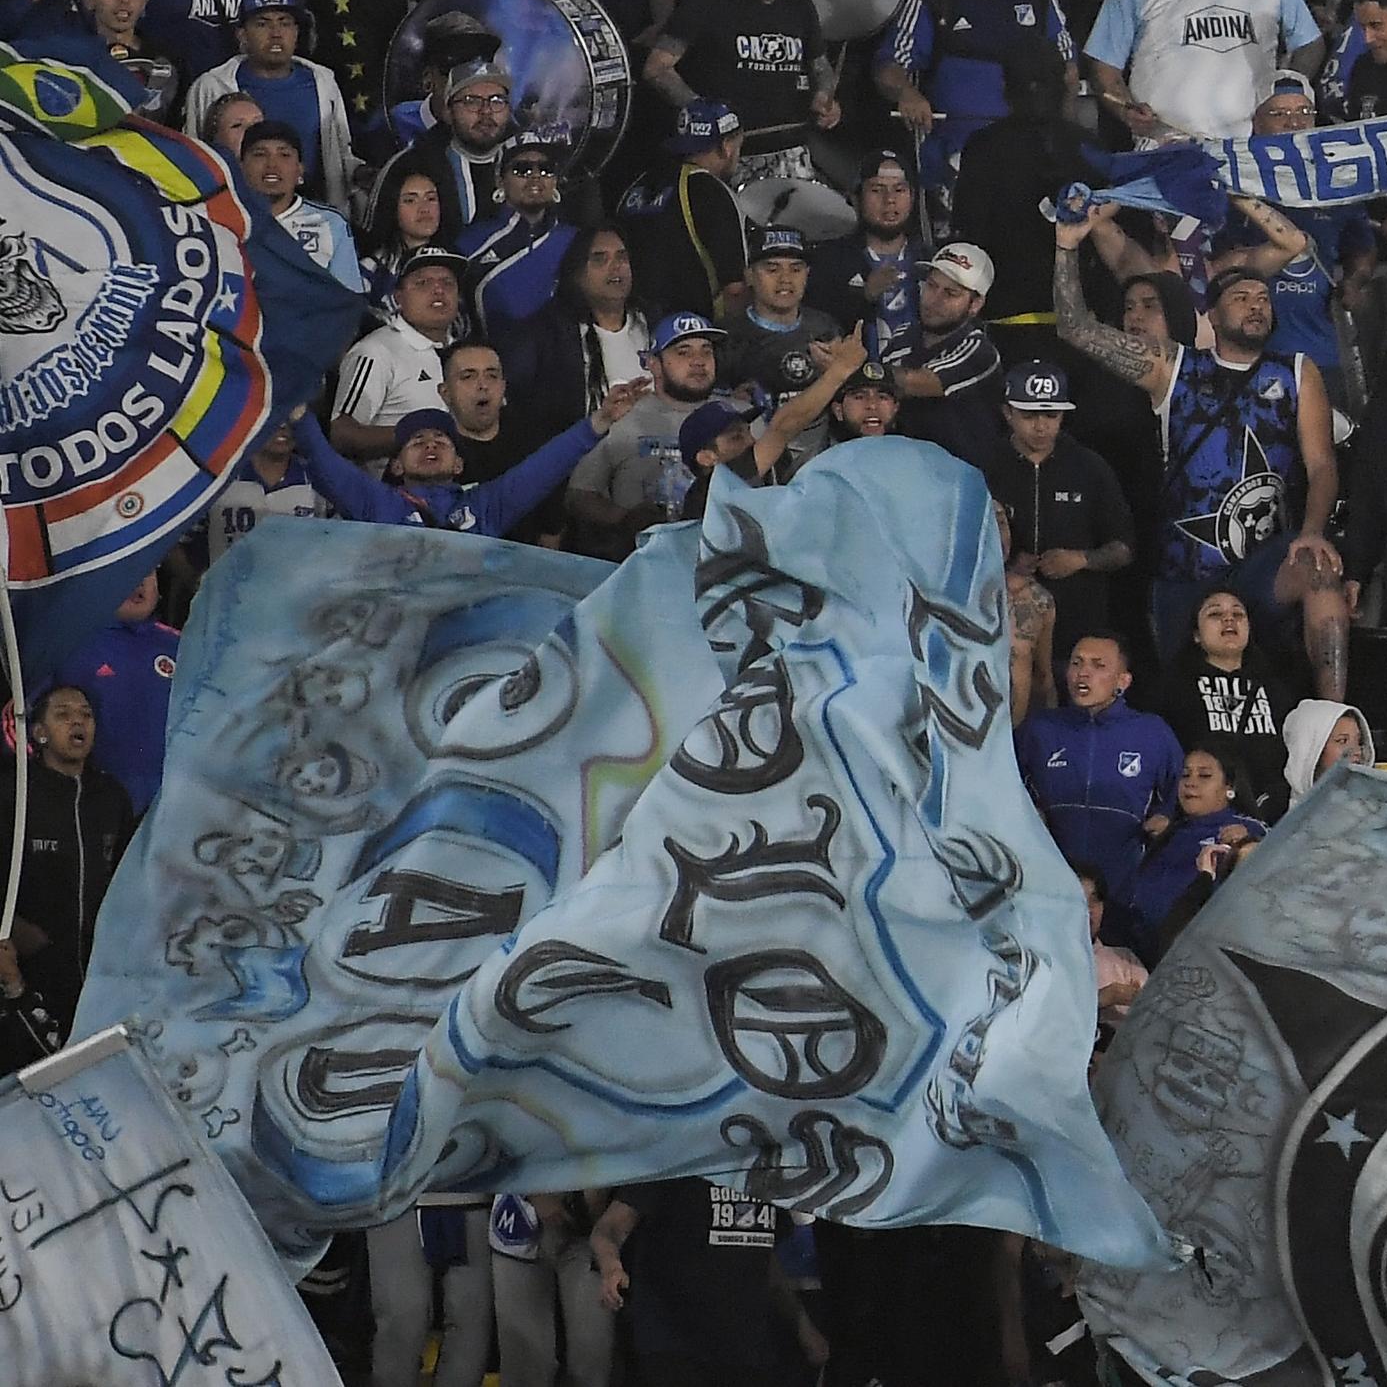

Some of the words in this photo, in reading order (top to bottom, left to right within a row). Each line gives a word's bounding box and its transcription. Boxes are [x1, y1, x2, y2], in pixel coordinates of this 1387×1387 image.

[1185, 14, 1258, 45] ANDINA
[148, 203, 214, 386] LADOS
[1033, 376, 1053, 393] 79
[0, 381, 166, 496] TODOS
[221, 507, 257, 535] 10
